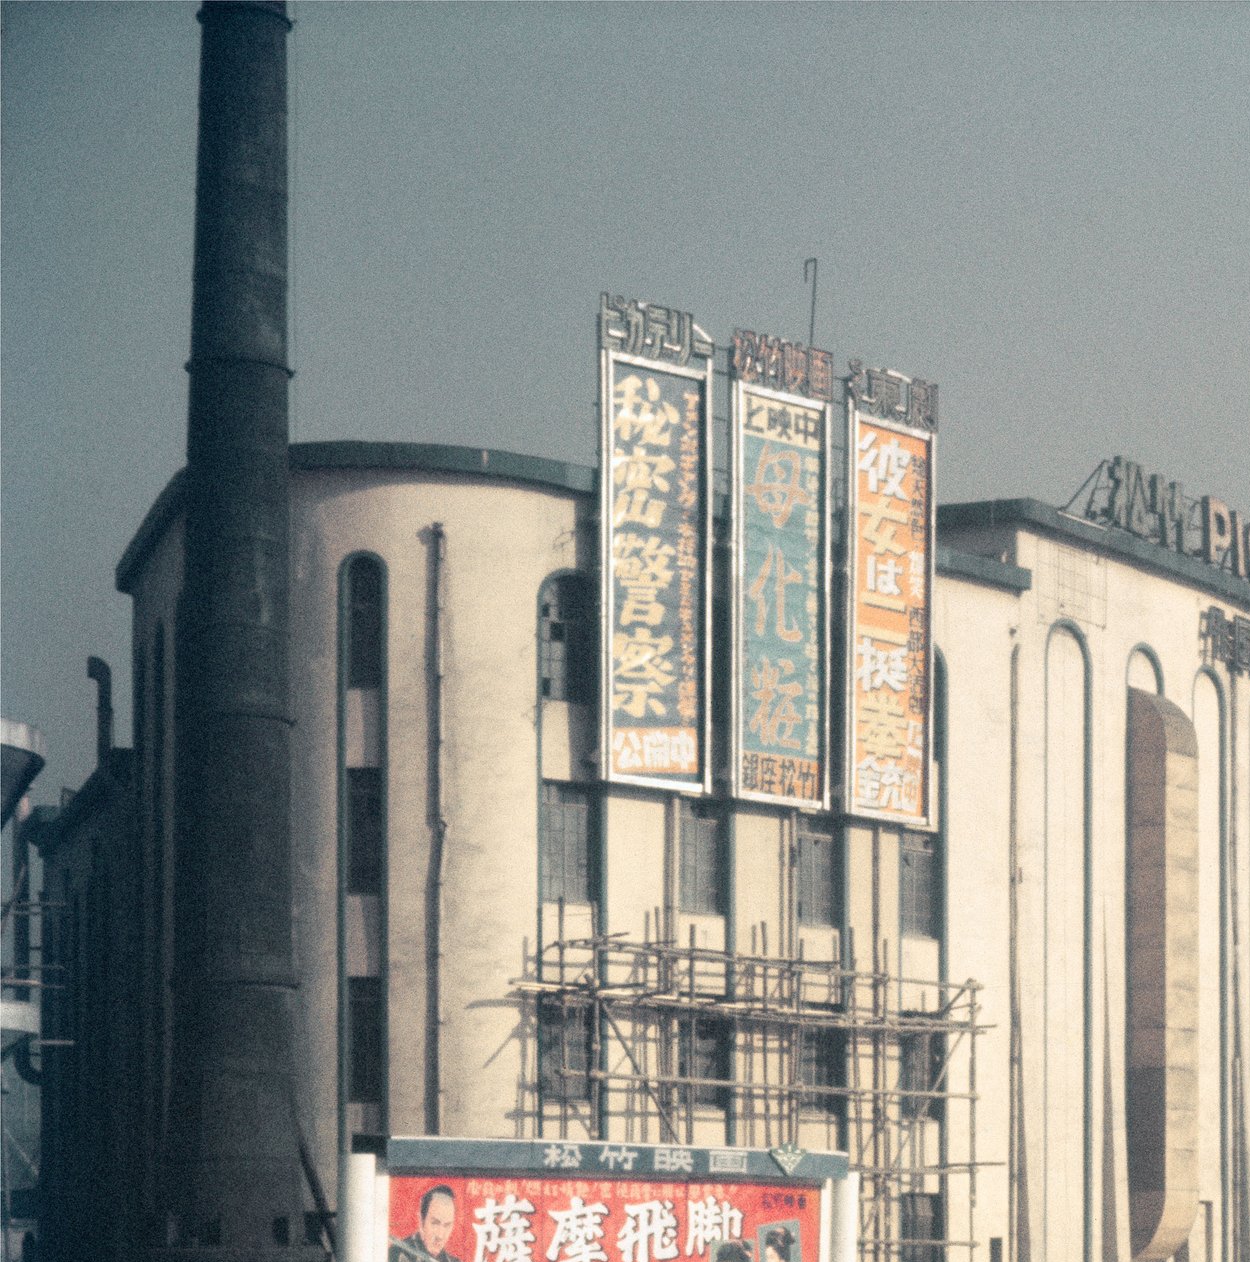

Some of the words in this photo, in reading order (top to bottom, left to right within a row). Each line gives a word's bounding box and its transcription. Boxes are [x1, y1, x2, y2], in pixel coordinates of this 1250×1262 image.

[600, 291, 714, 367] ピカデリー
[744, 395, 820, 446] 上映中
[611, 374, 681, 718] 秘密警察
[612, 730, 696, 770] 公開中
[743, 753, 818, 801] 銀座松竹
[543, 1144, 749, 1174] 松竹映画
